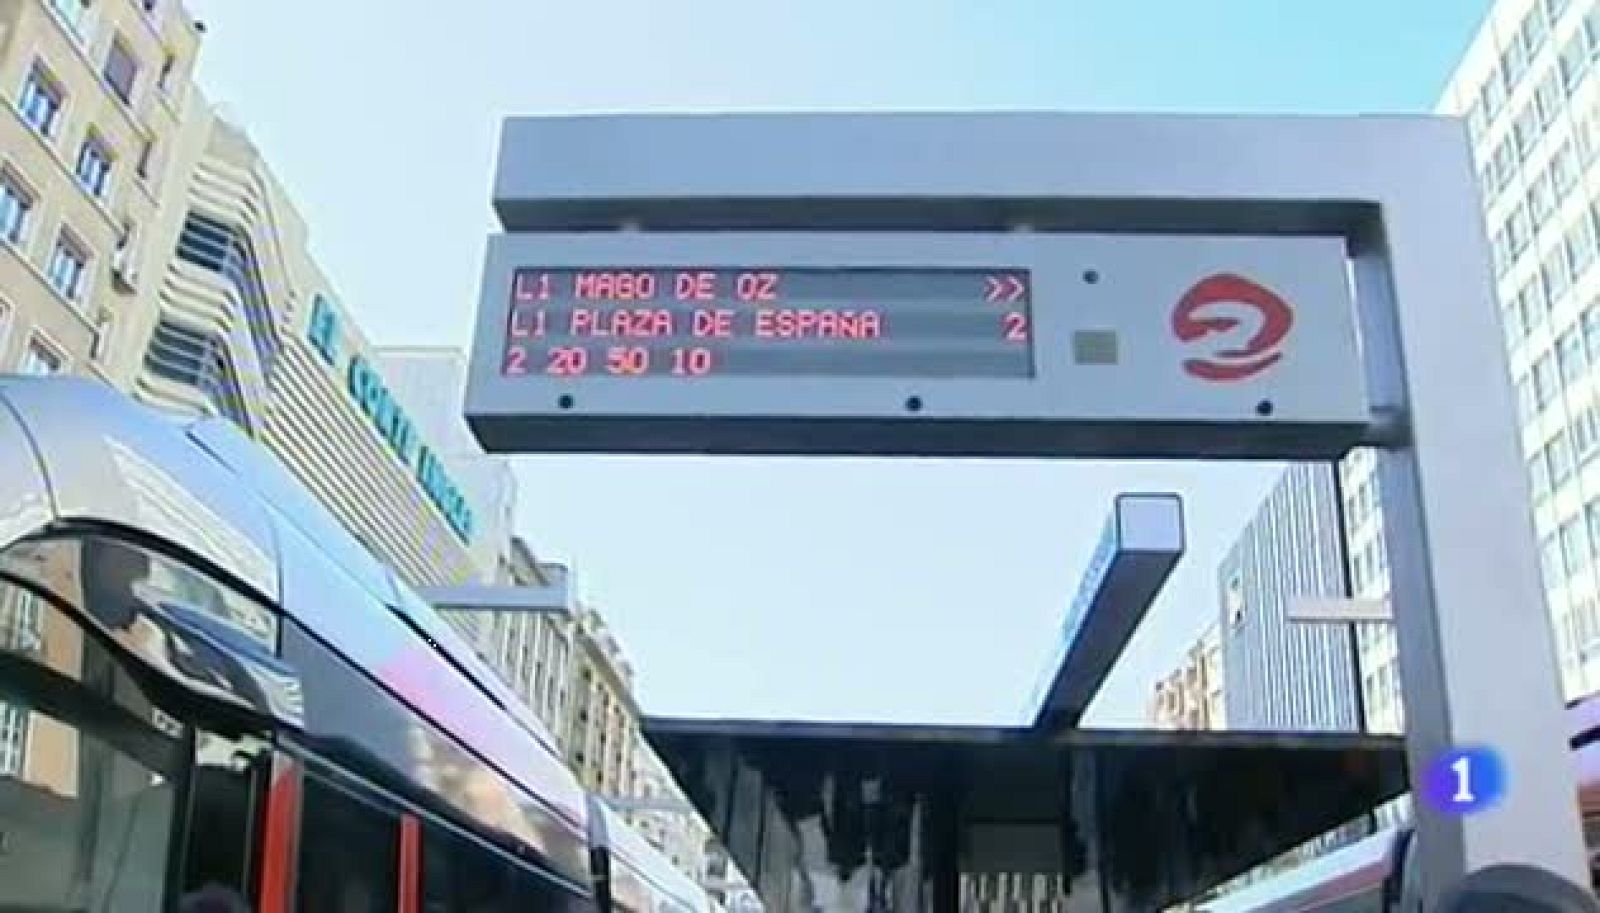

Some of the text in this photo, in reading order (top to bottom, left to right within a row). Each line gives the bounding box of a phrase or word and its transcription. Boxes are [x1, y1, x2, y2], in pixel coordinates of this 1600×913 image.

[516, 273, 550, 300] L1
[676, 274, 716, 300] DE
[737, 274, 777, 300] OZ
[511, 310, 1027, 341] L1 PLAZA DE ESPAÑA 2
[506, 347, 711, 375] 2 20 50 10
